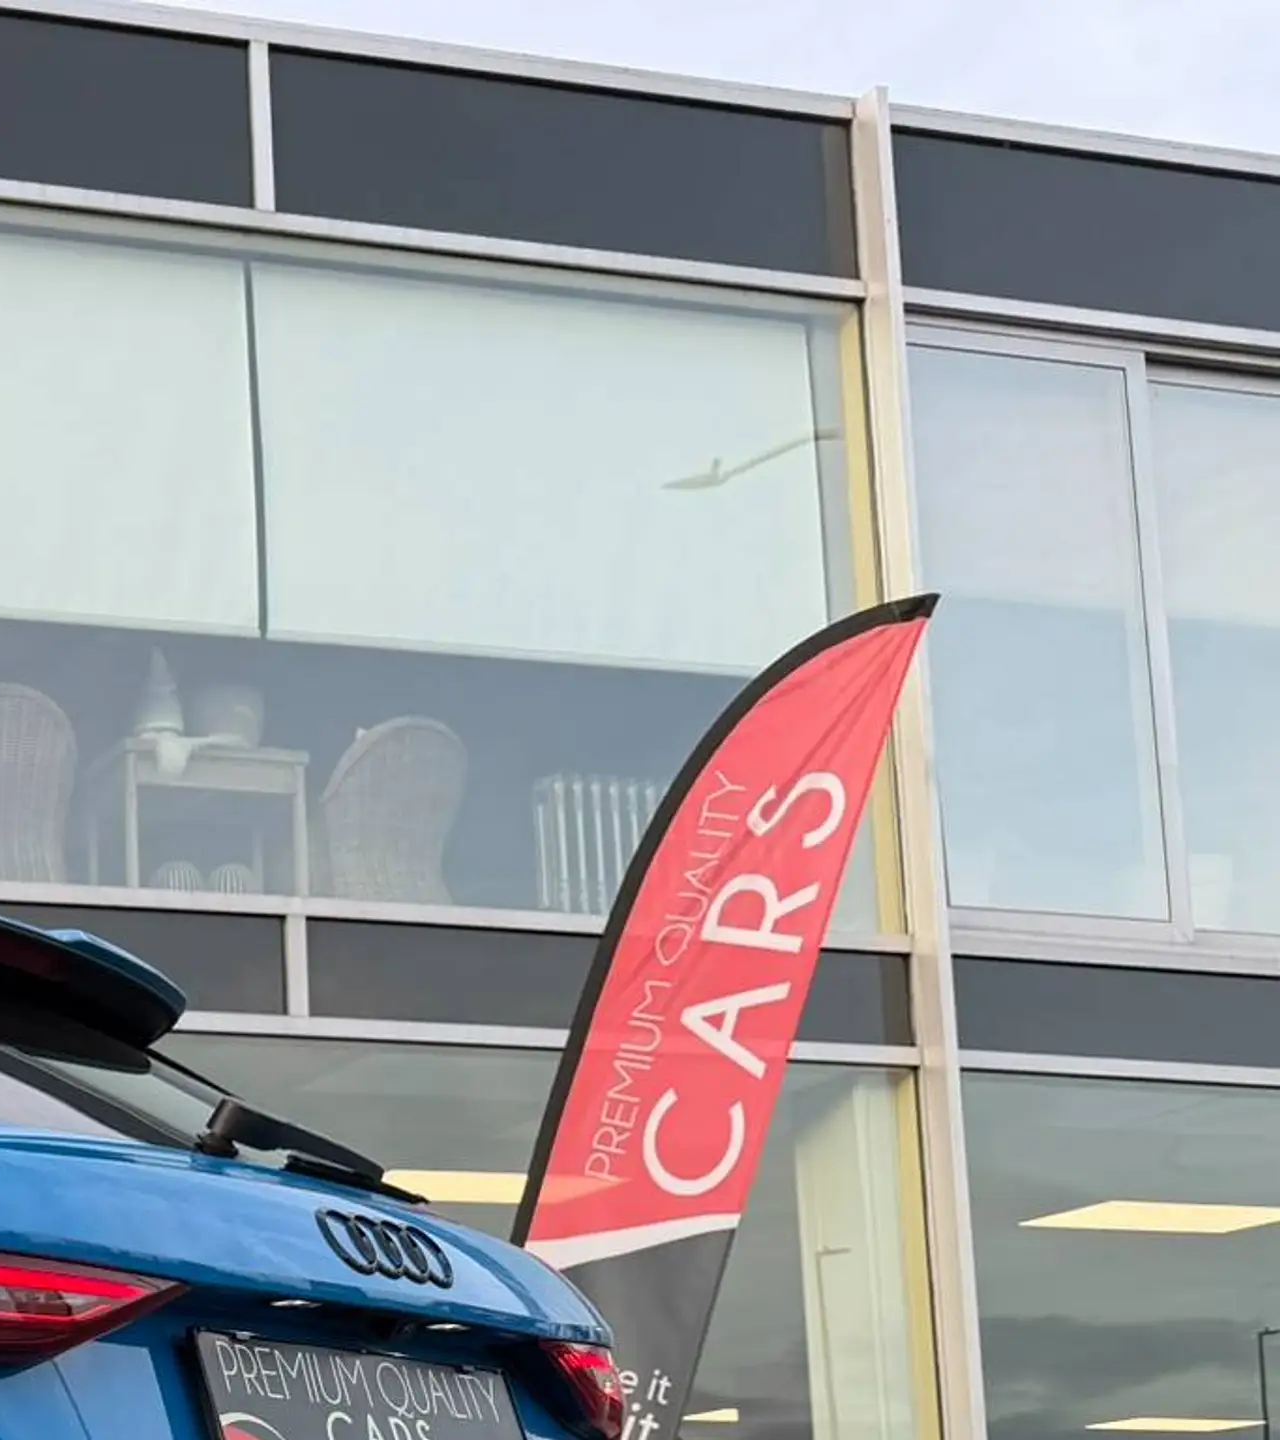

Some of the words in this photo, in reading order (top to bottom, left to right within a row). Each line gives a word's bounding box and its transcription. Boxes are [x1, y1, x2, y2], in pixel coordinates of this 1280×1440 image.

[583, 979, 671, 1183] PREMIUM
[655, 770, 746, 967] QUALITY
[642, 771, 846, 1197] CARS
[214, 1339, 374, 1409] PREMIUM
[376, 1361, 500, 1423] QUALITY
[646, 1369, 672, 1405] it
